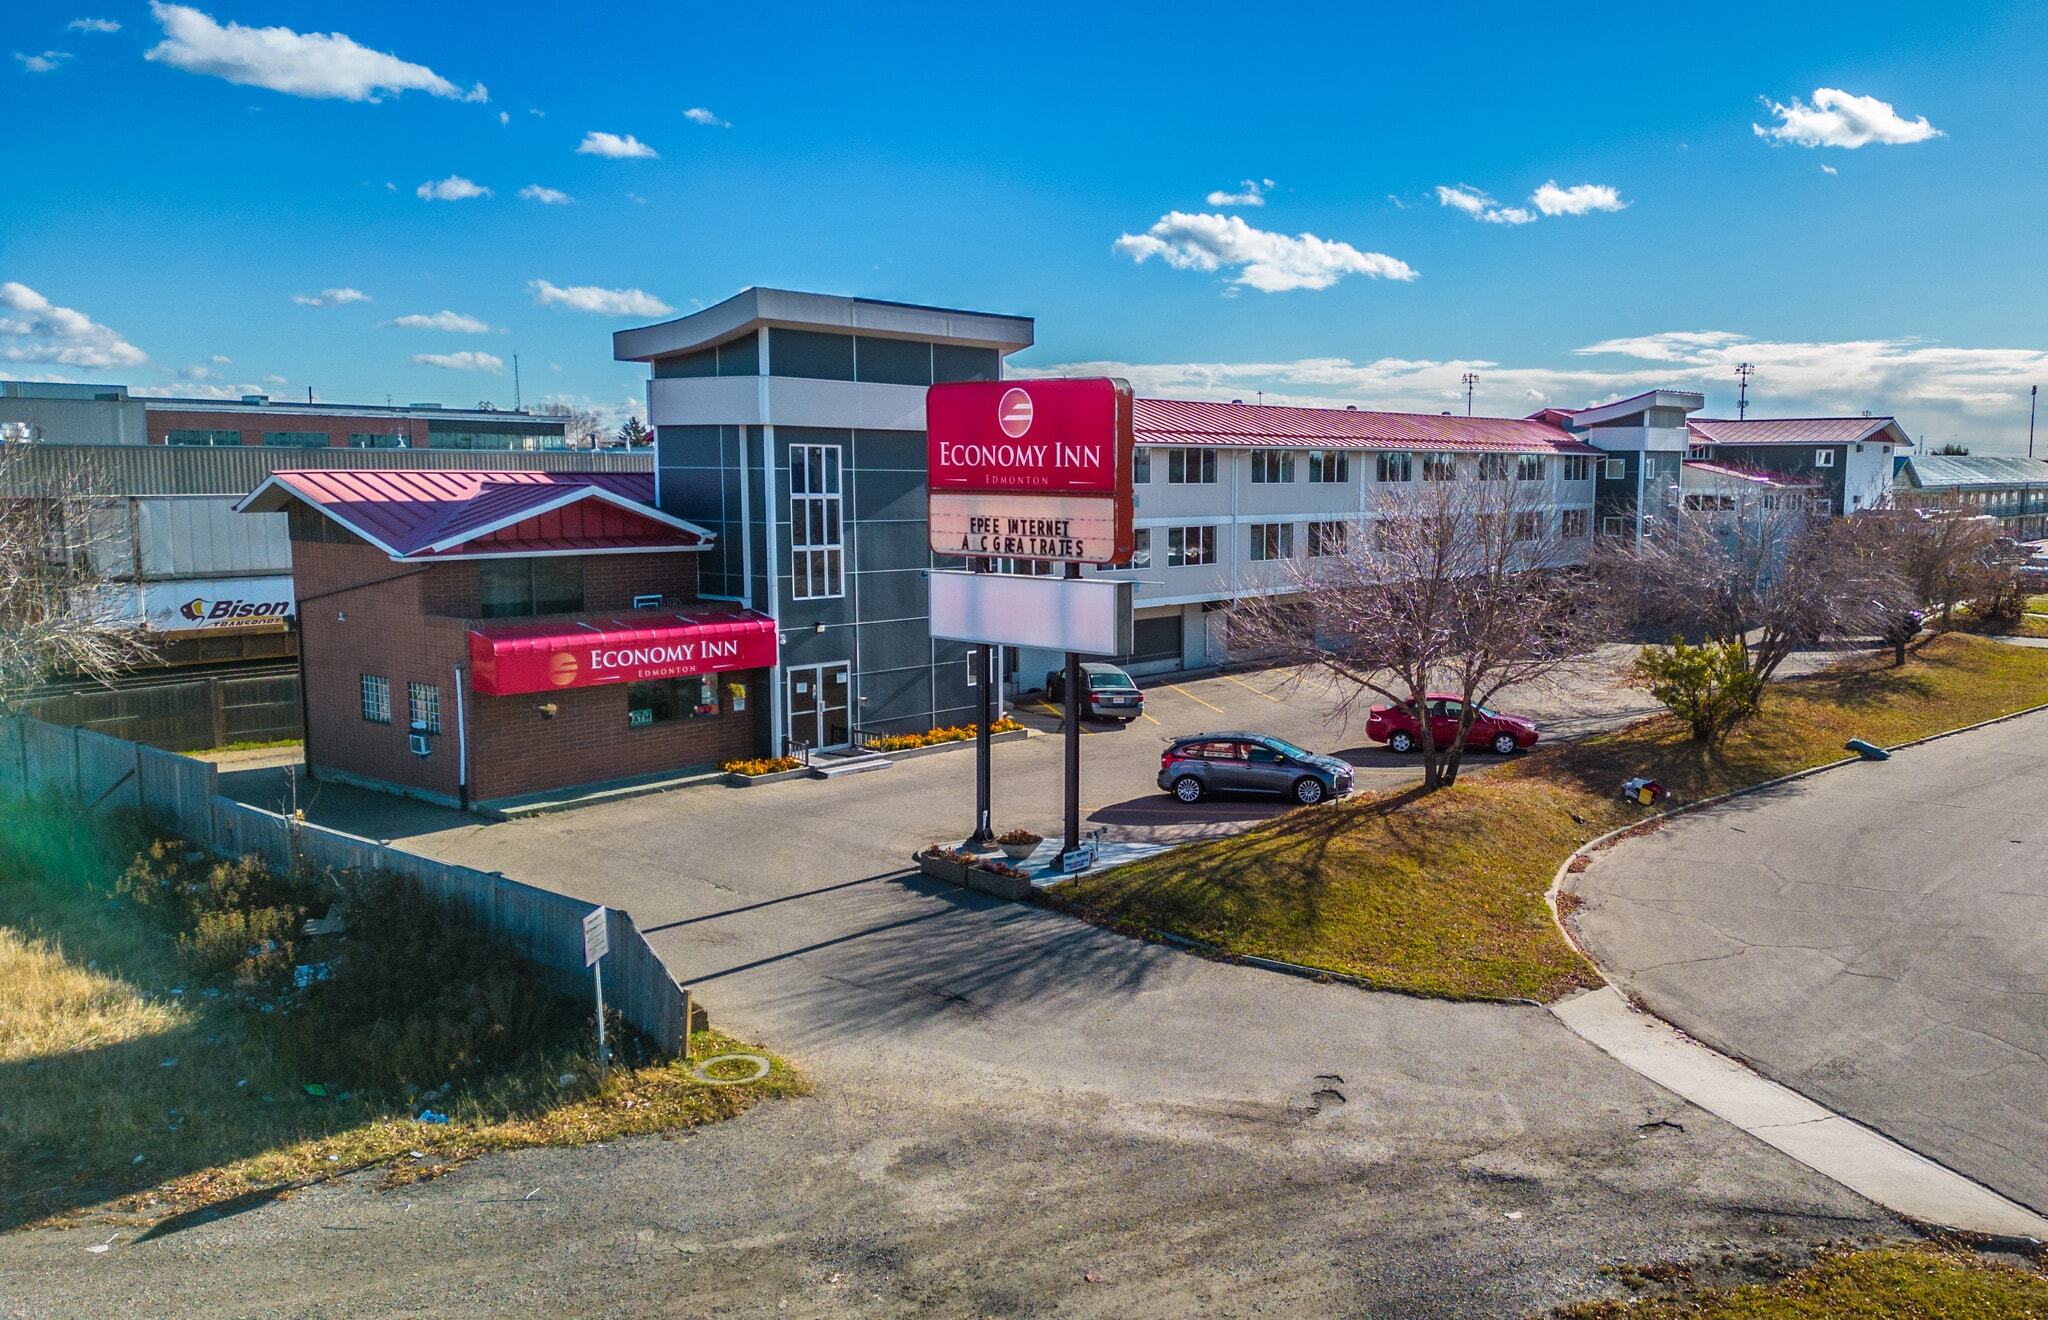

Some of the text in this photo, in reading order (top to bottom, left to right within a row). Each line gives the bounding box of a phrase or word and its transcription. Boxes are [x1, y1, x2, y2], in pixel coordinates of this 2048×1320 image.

[939, 441, 1101, 468] ECONOMY INN
[985, 474, 1048, 485] EDMONTON
[1008, 519, 1069, 538] INTERNET
[207, 599, 289, 619] Bison
[591, 640, 738, 669] ECONOMY INN
[638, 666, 697, 677] EDMONTON
[633, 713, 652, 724] ATM
